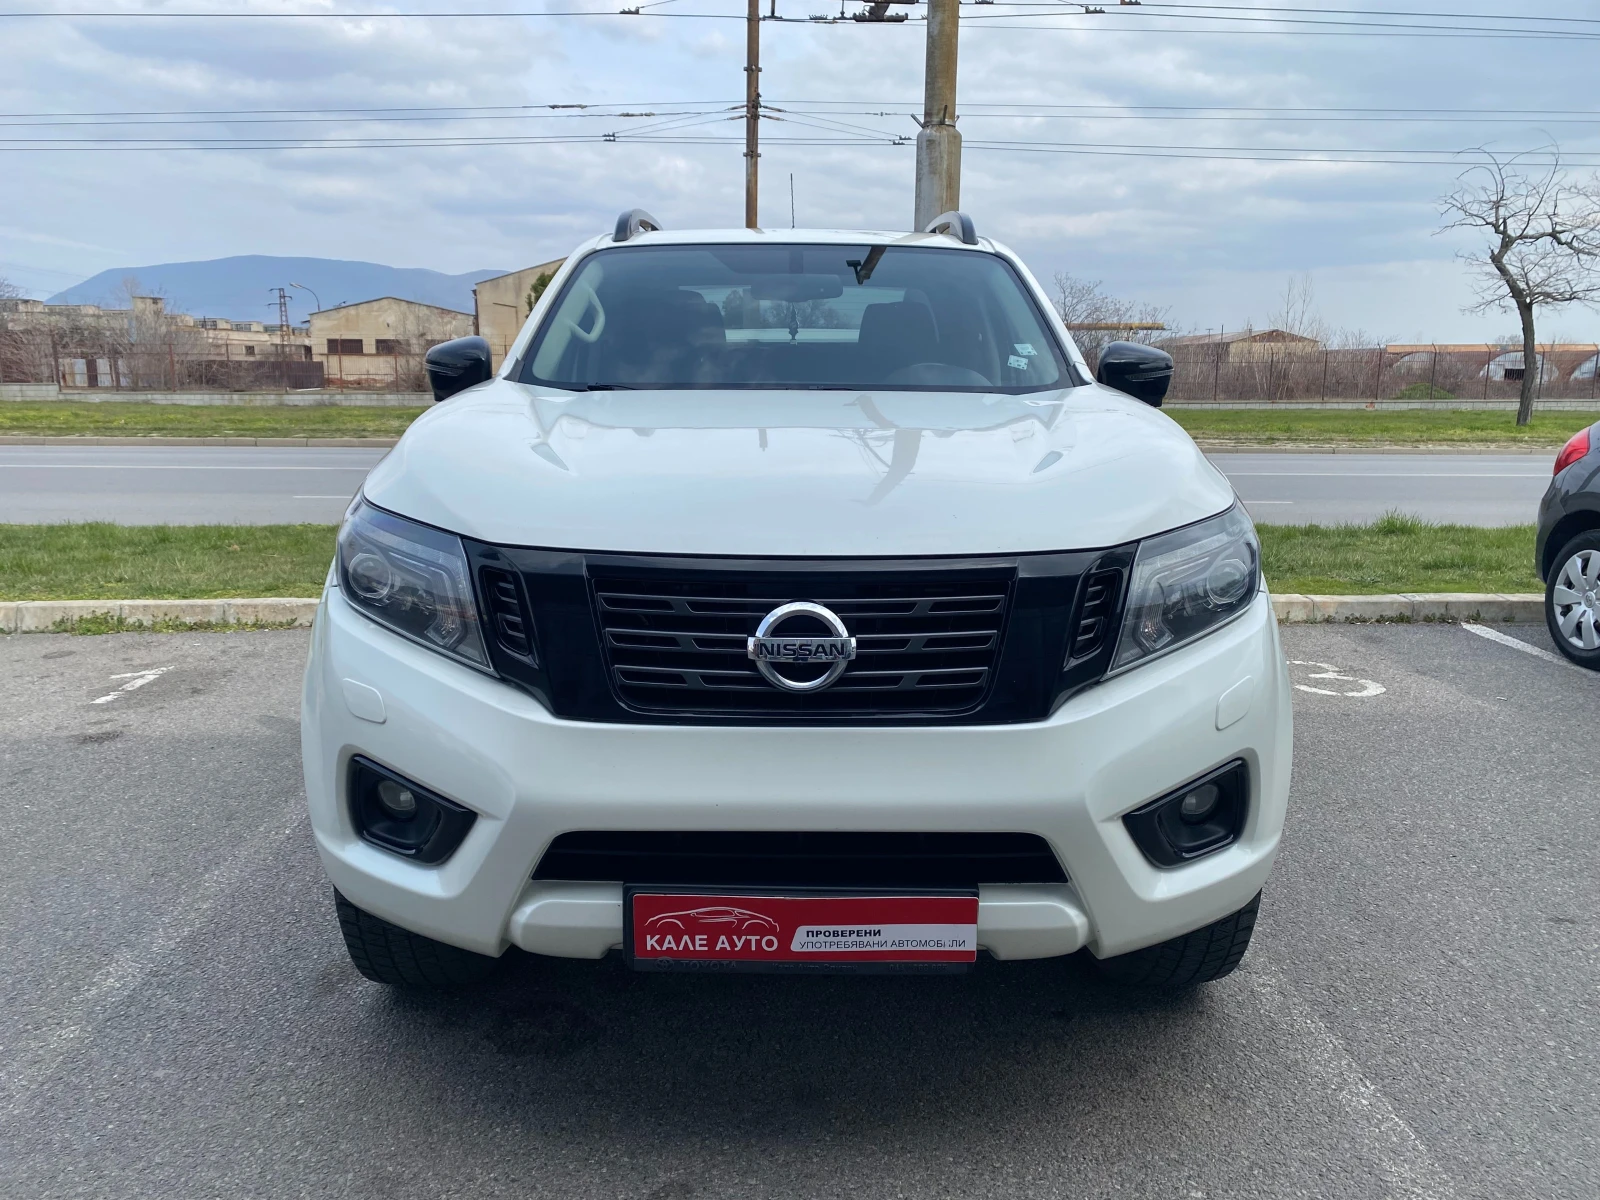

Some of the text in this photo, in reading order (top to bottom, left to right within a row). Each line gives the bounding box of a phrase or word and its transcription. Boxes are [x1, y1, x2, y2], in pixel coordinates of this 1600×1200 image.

[759, 642, 845, 657] NISSAN
[806, 929, 882, 938] ПРОВЕРЕНИ
[645, 934, 779, 951] КАЛЕ АУТО
[799, 940, 888, 949] УПОТРЕБЯВАНИ
[680, 960, 737, 970] TOYOTA
